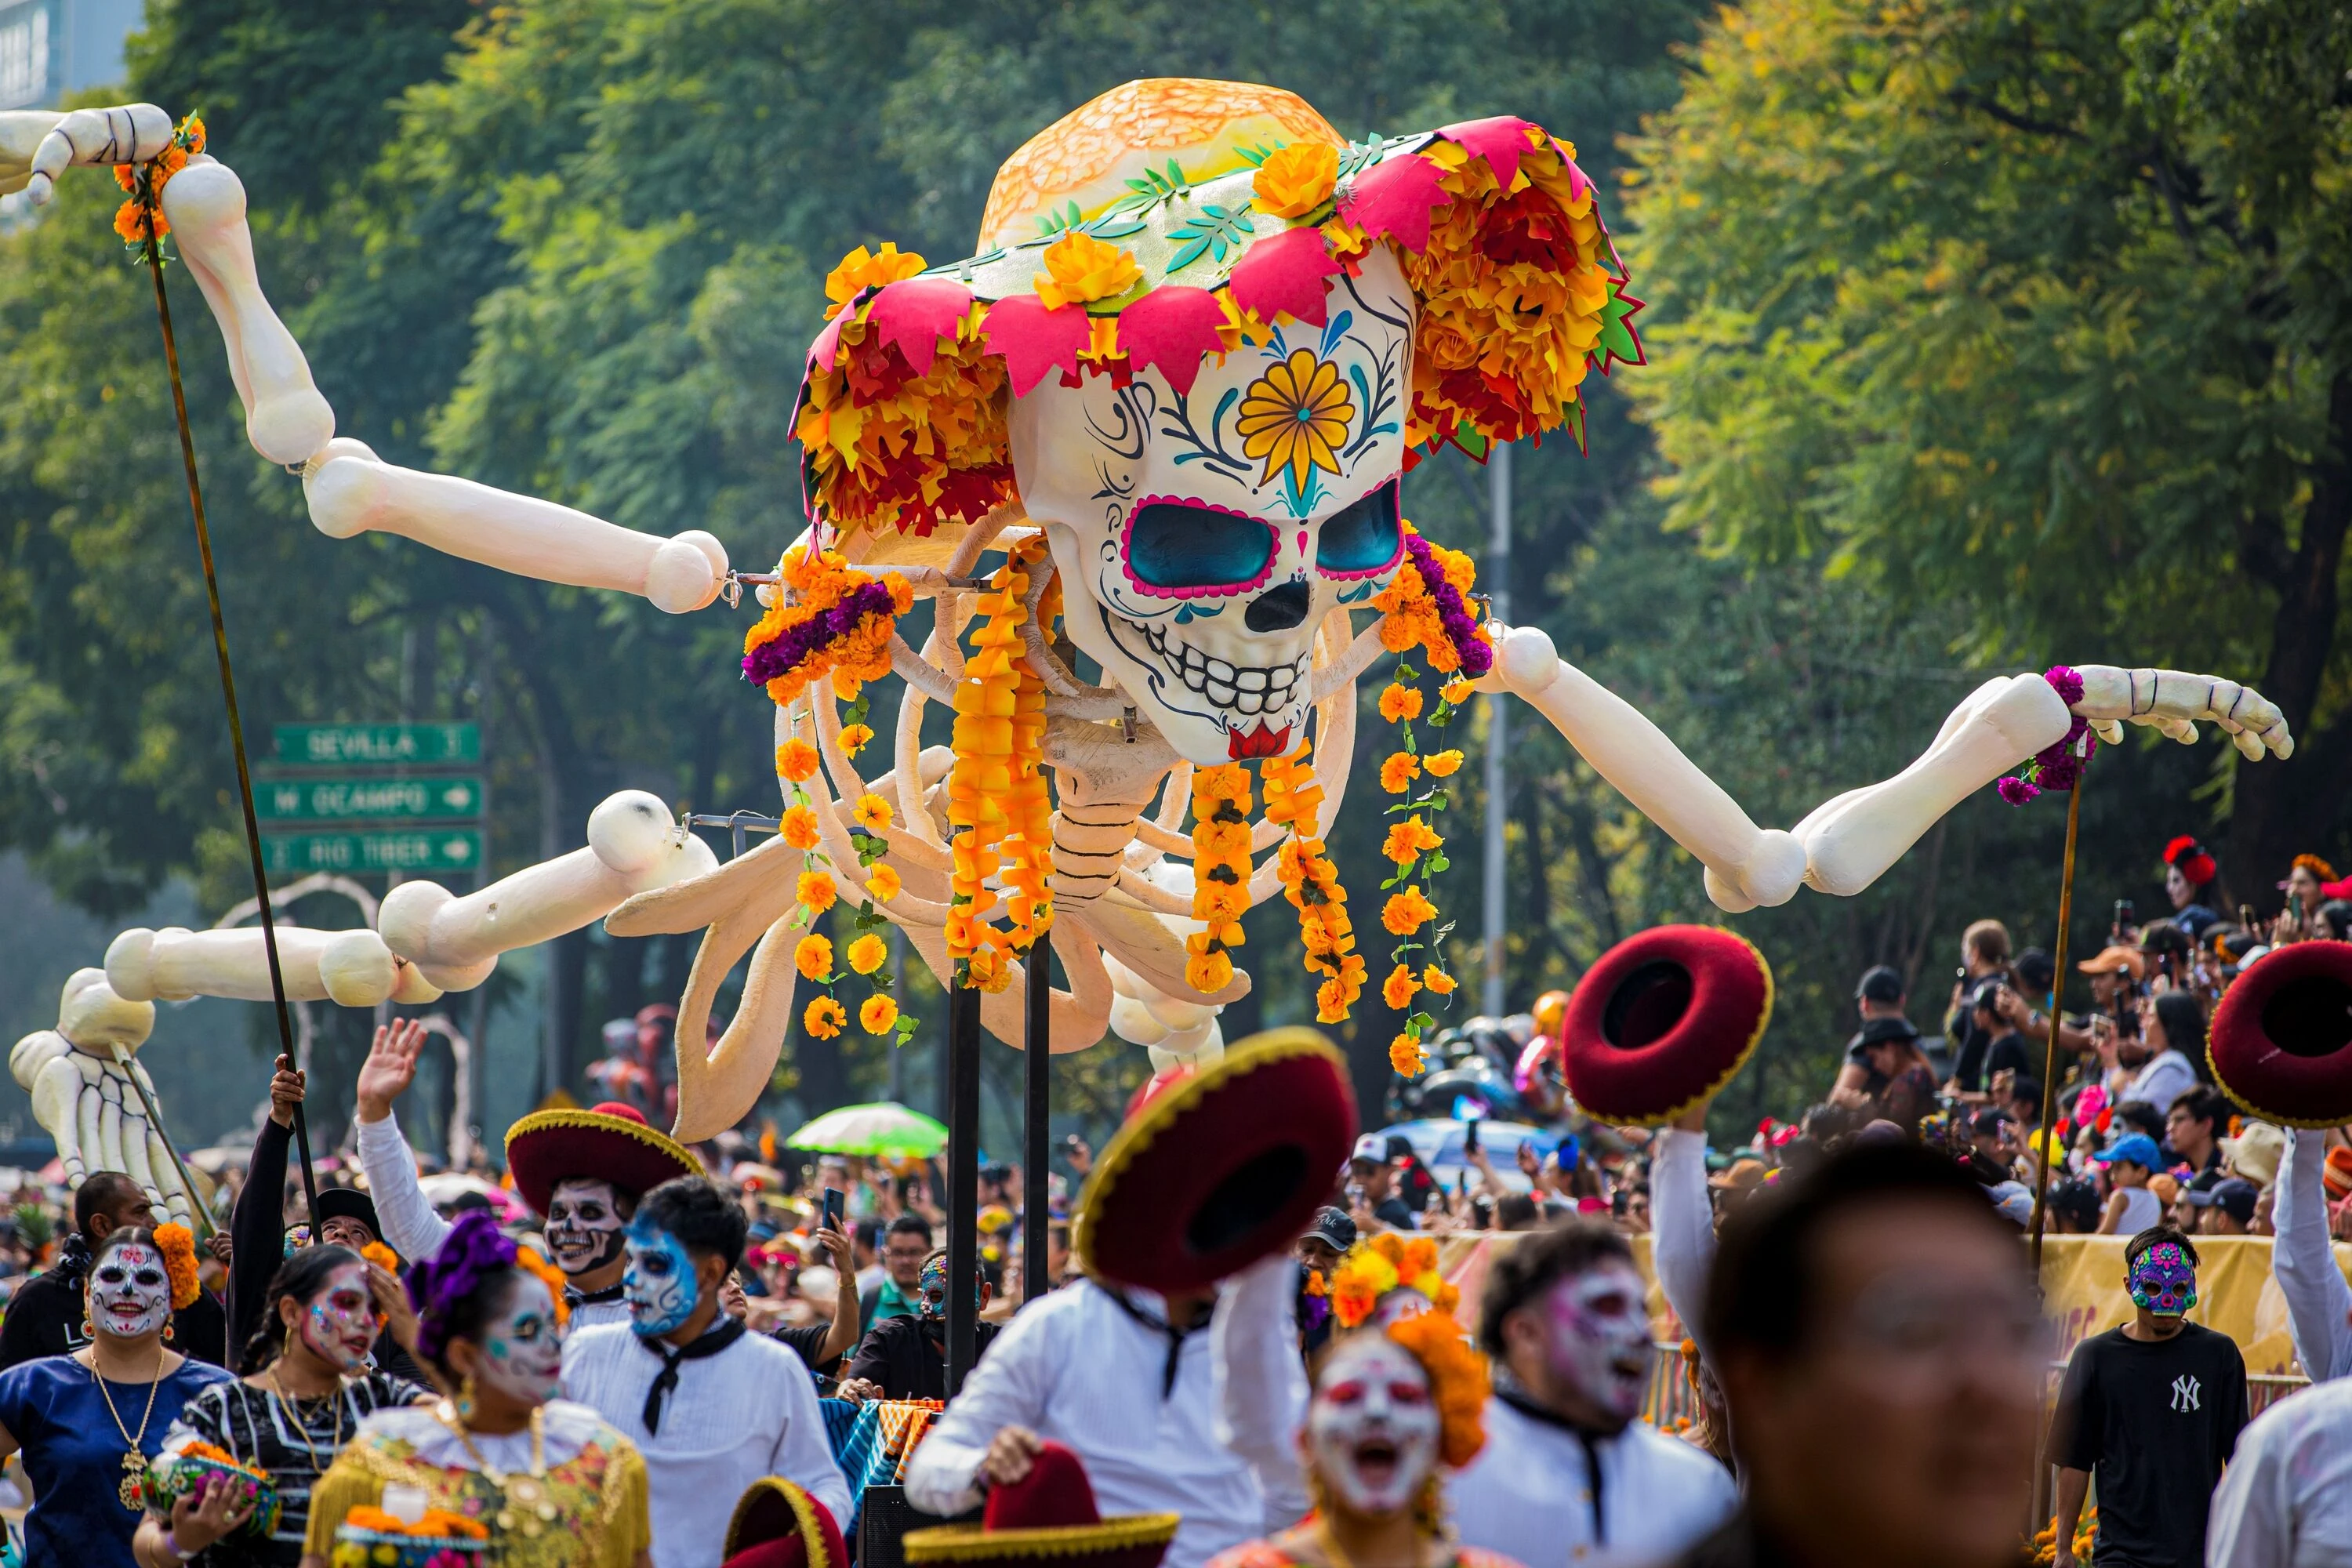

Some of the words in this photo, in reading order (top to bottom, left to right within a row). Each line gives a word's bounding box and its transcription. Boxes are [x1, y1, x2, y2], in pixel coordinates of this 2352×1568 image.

[307, 730, 416, 760] SEVILLA
[313, 785, 429, 814] OCAMPO
[363, 837, 430, 866] TIBER
[2170, 1374, 2201, 1410] NY
